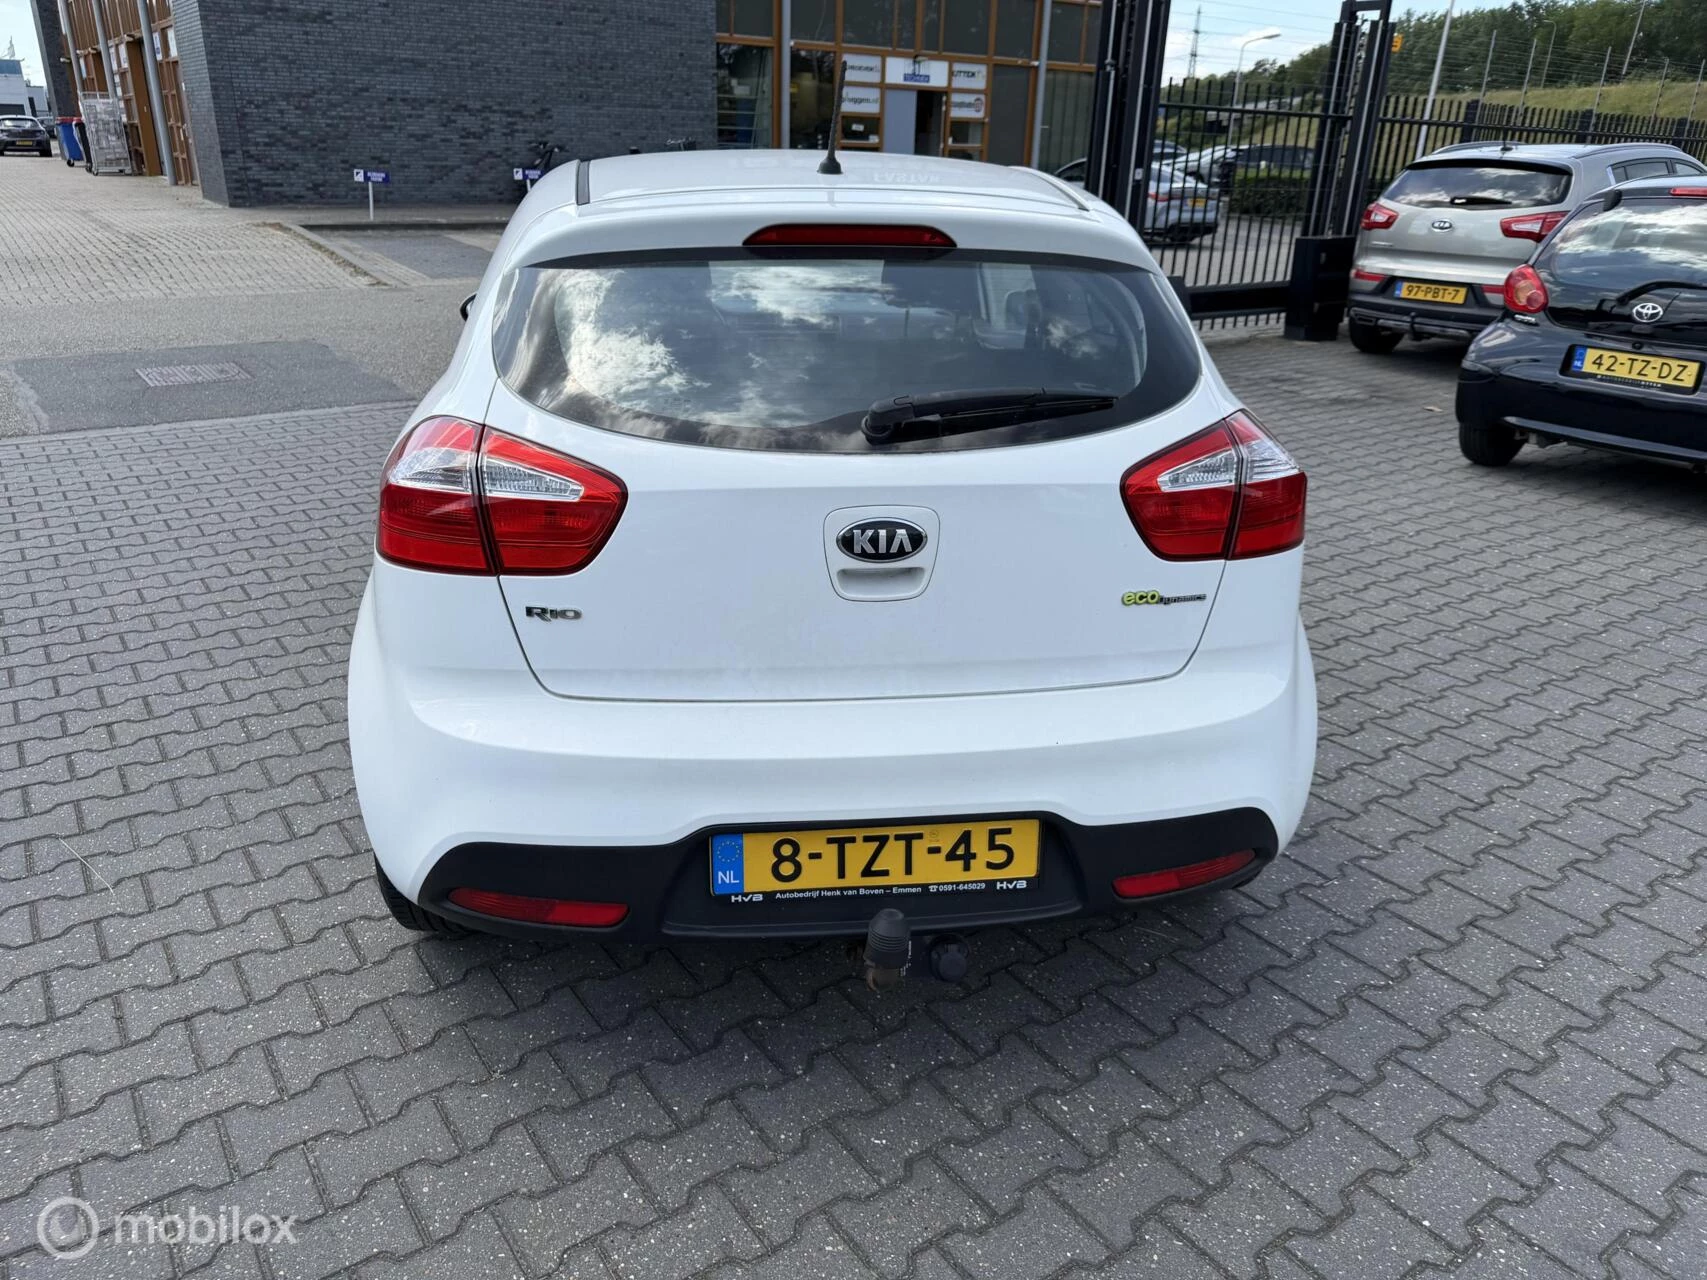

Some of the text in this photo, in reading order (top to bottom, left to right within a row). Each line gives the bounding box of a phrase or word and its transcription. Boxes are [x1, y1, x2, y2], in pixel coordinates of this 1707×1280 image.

[1406, 284, 1460, 301] 97-PBT-7
[1592, 353, 1688, 382] 42-TZ-DZ
[853, 529, 913, 554] KIA
[771, 827, 1014, 883] 8-TZT-45
[717, 870, 740, 885] NL
[775, 890, 820, 900] Autobedrijf
[821, 889, 841, 897] Henk
[859, 887, 884, 895] Boven
[892, 886, 922, 894] Emmen
[938, 882, 986, 892] 0591-645029
